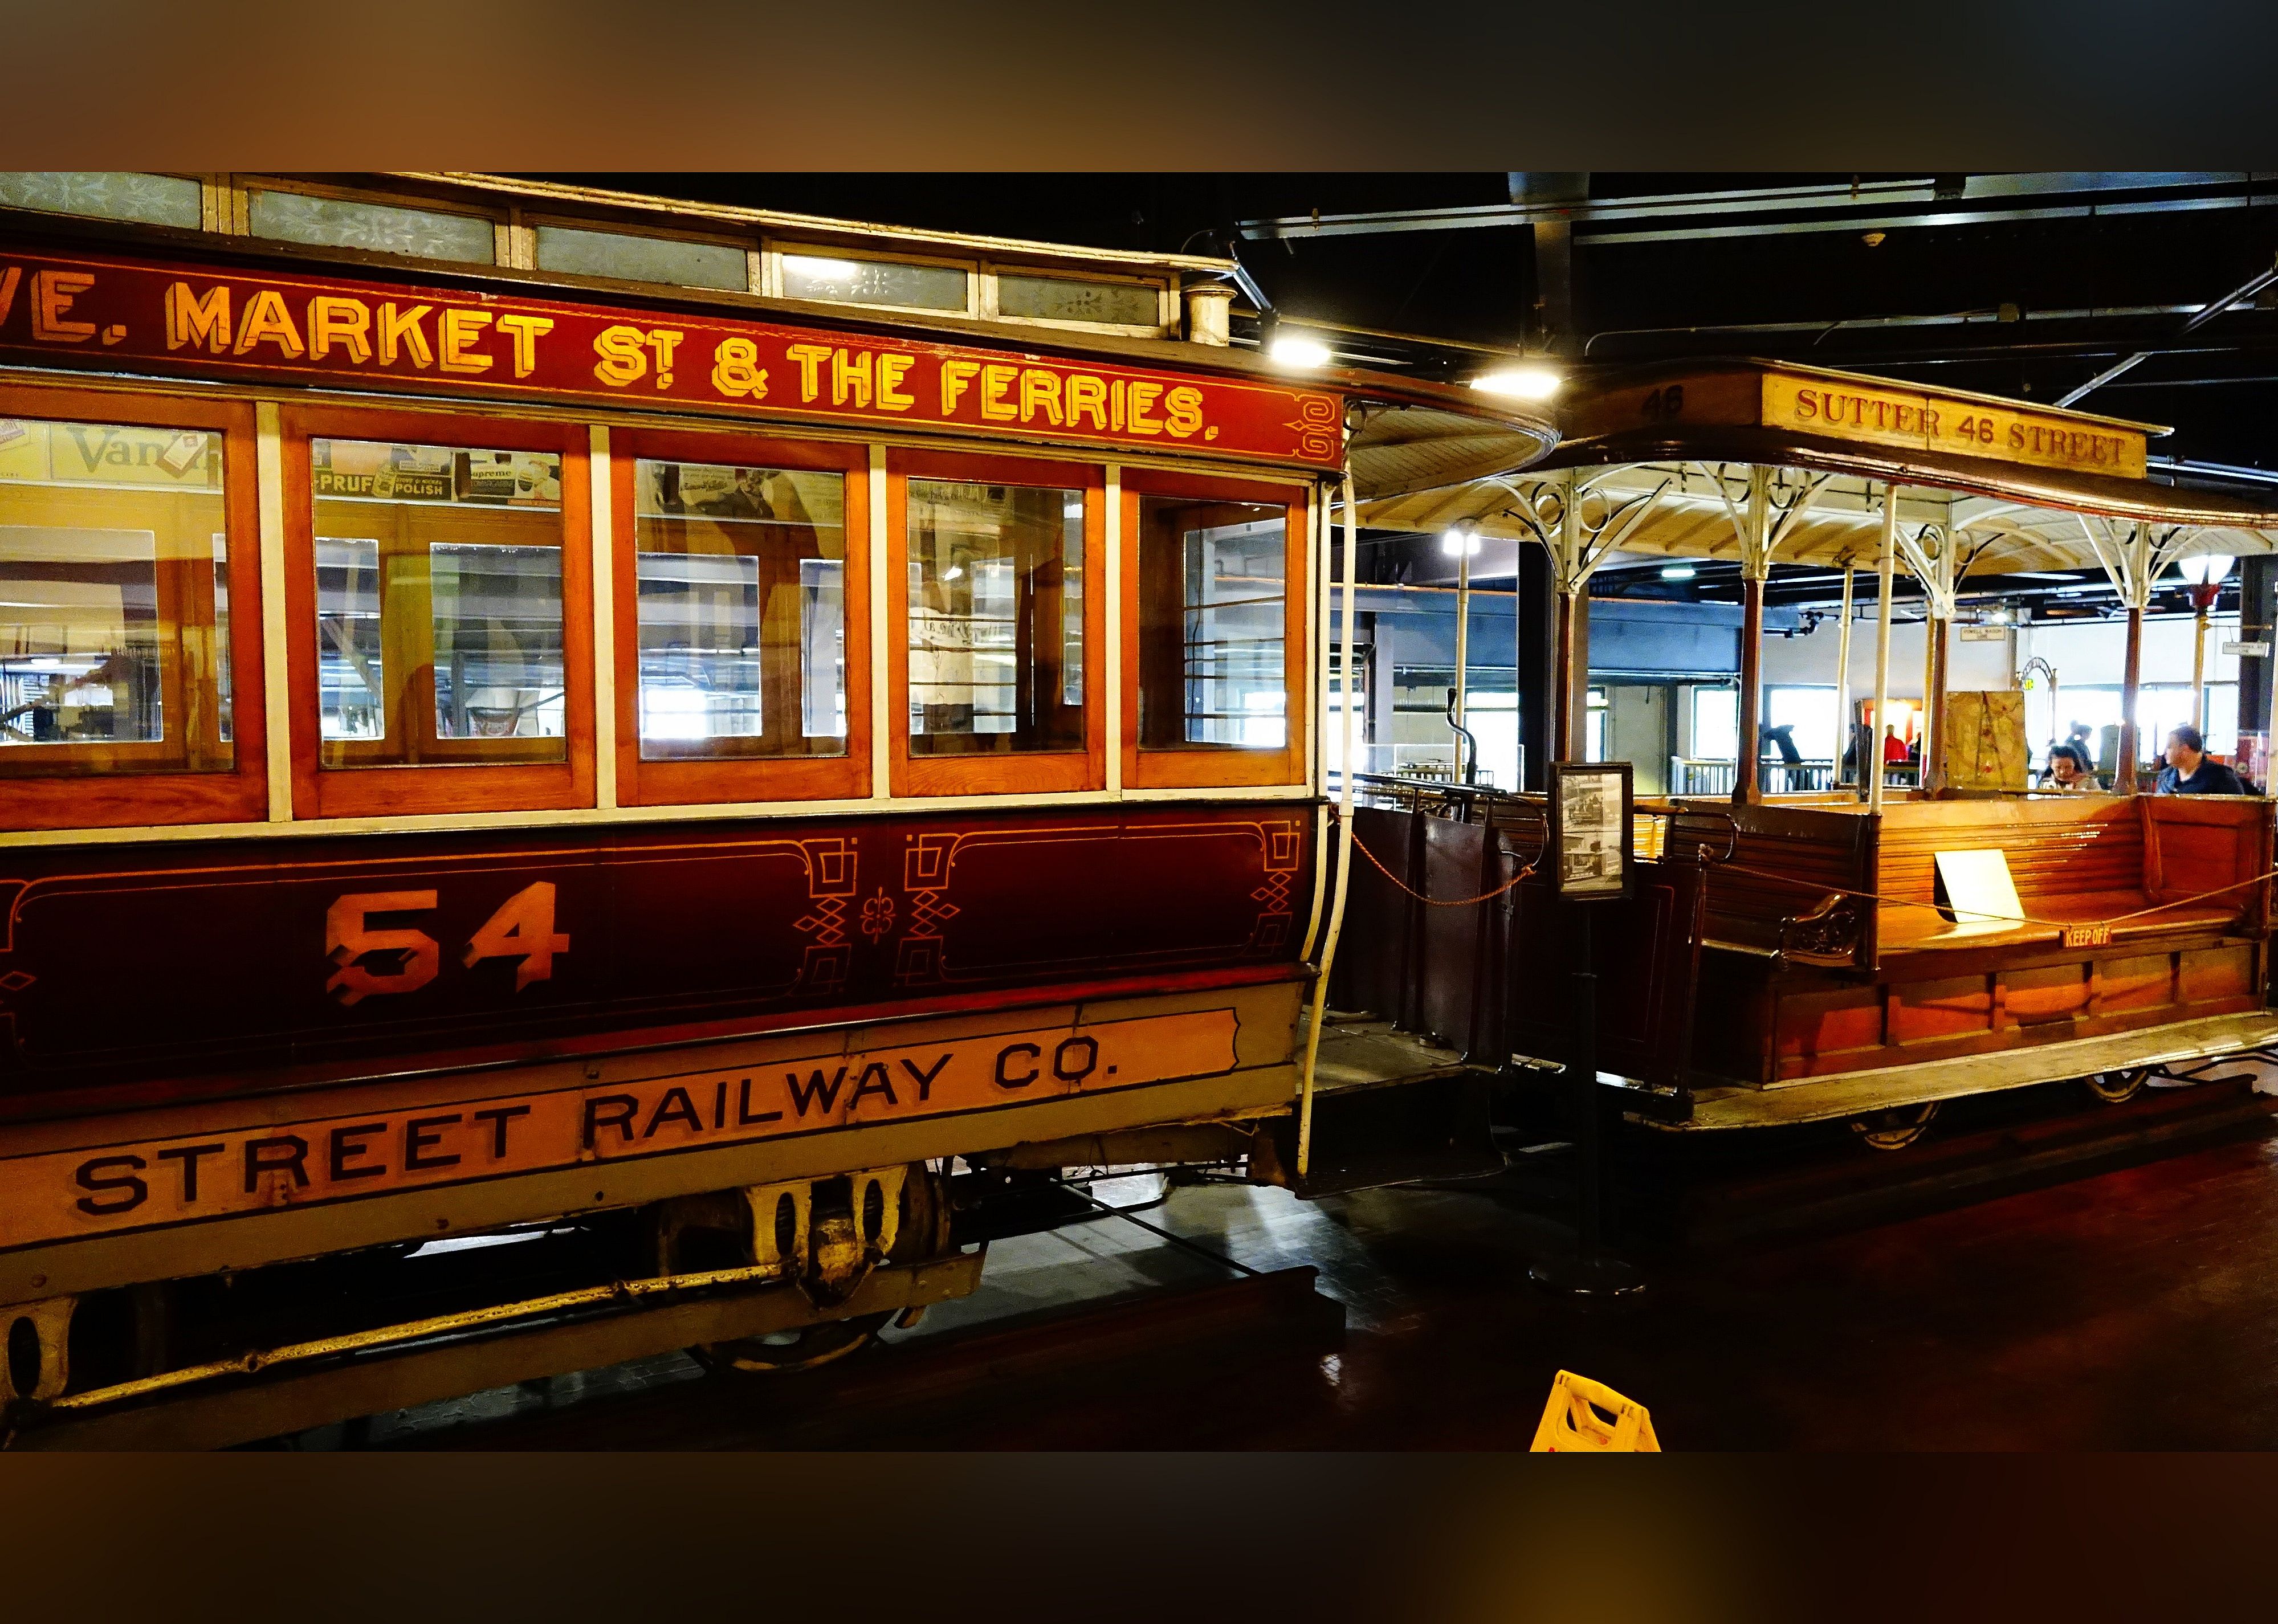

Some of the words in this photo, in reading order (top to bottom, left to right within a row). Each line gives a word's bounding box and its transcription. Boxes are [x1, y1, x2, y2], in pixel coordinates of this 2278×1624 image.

[165, 282, 554, 379] MARKET
[711, 337, 769, 400] &
[786, 344, 915, 411] THE
[941, 360, 1219, 441] FERRIES.
[1641, 385, 1684, 418] 46
[1795, 389, 1941, 438] SUTTER
[1957, 415, 1994, 444] 46
[2007, 423, 2125, 465] STREET
[396, 483, 443, 495] POLISH
[325, 881, 570, 1007] 54
[2066, 929, 2092, 947] KEEP
[2092, 927, 2110, 945] OFF
[75, 1105, 531, 1216] STREET
[582, 1053, 955, 1150] RAILWAY
[994, 1035, 1119, 1090] CO.
